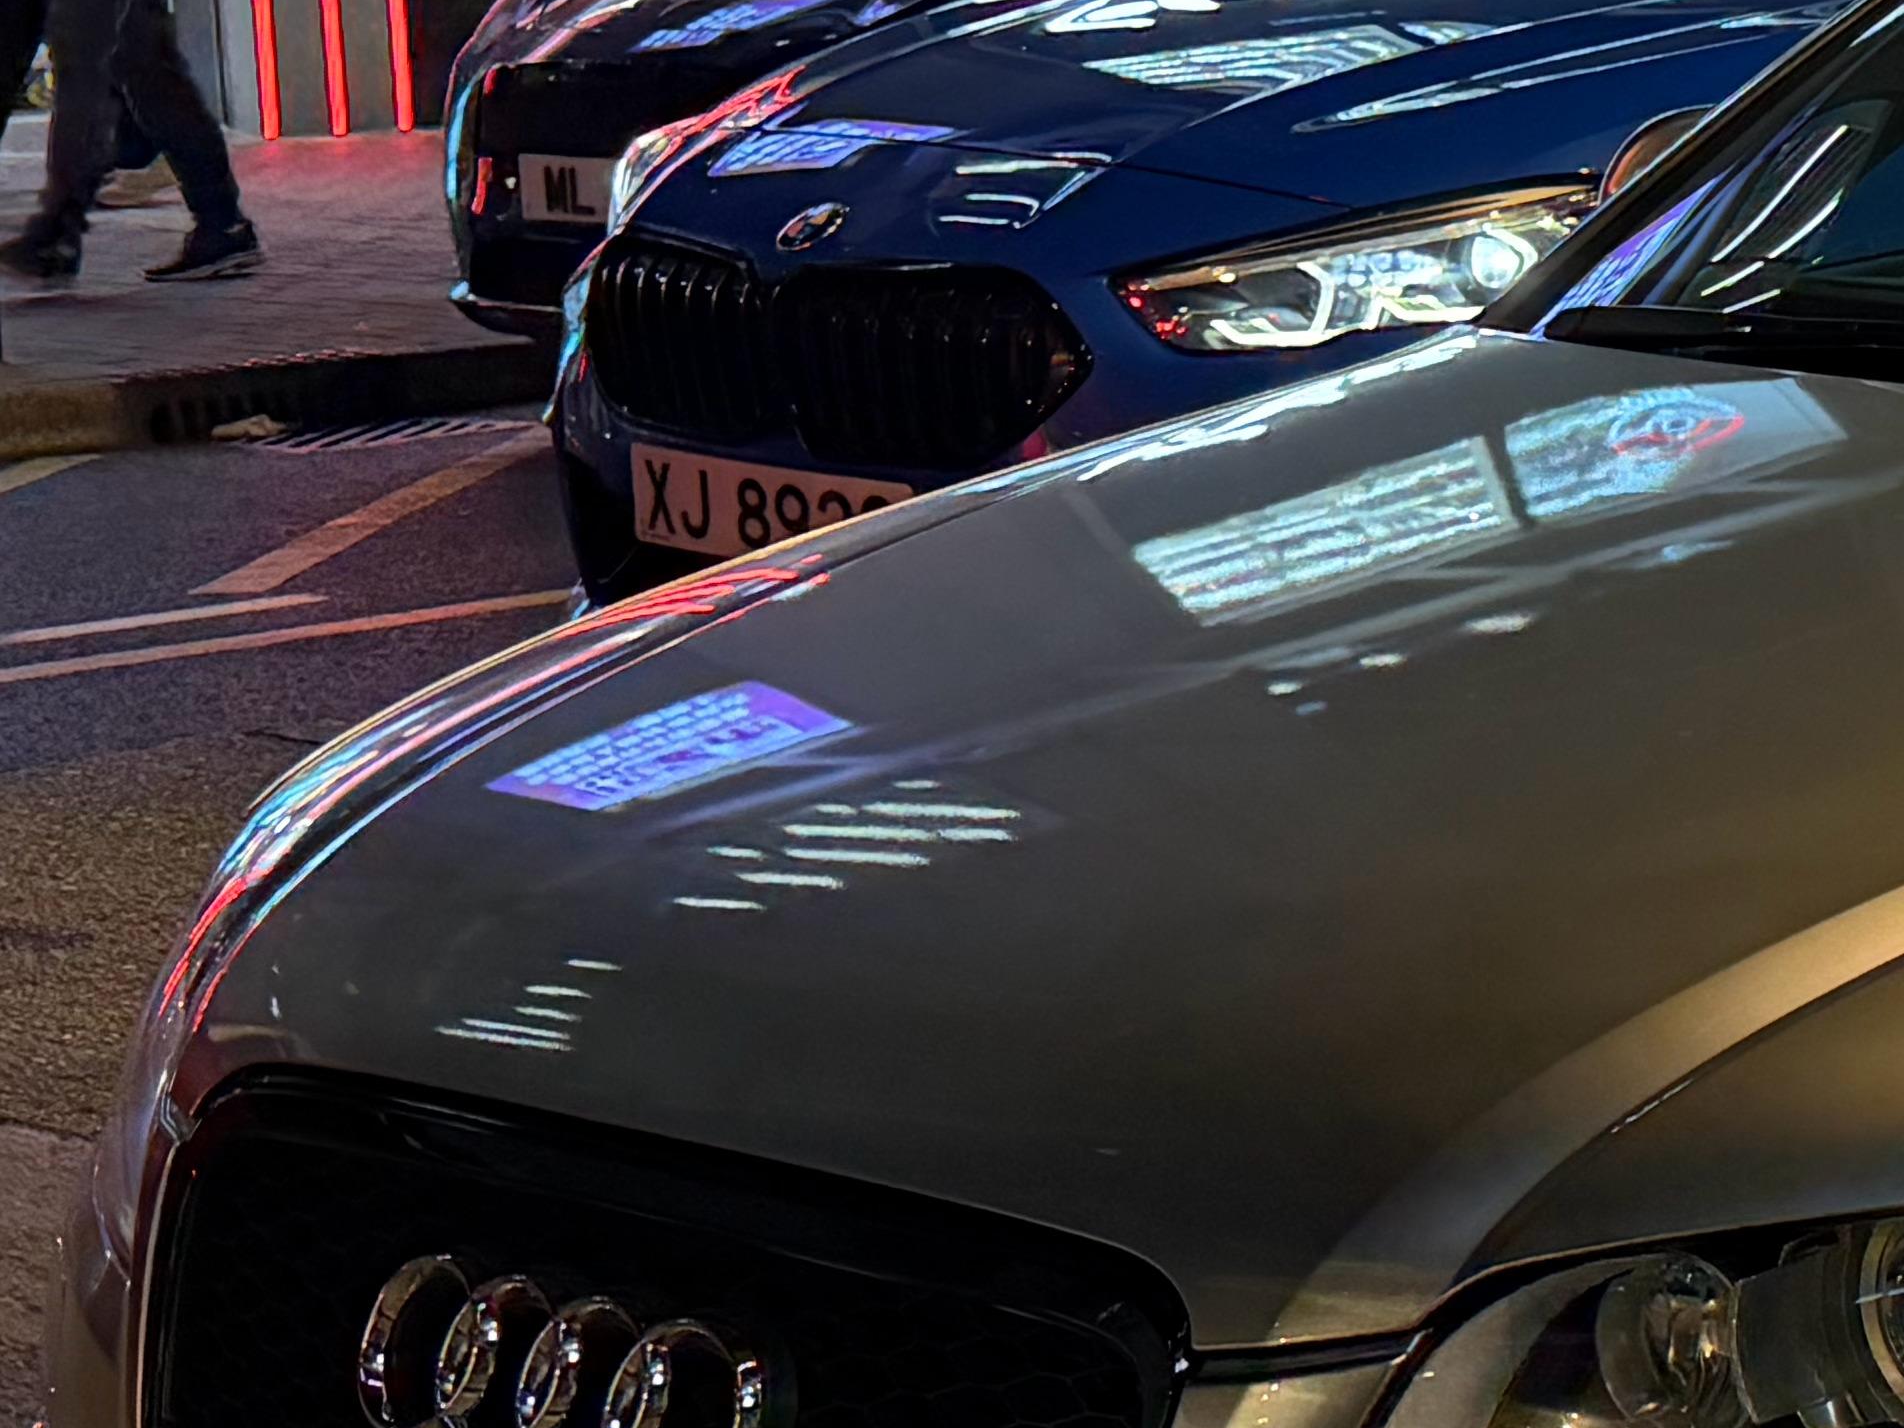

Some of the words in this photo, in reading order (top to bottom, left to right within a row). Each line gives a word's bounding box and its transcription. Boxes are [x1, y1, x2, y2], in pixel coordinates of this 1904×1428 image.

[543, 166, 596, 216] ML
[644, 458, 711, 540] XJ
[737, 477, 896, 550] 89
